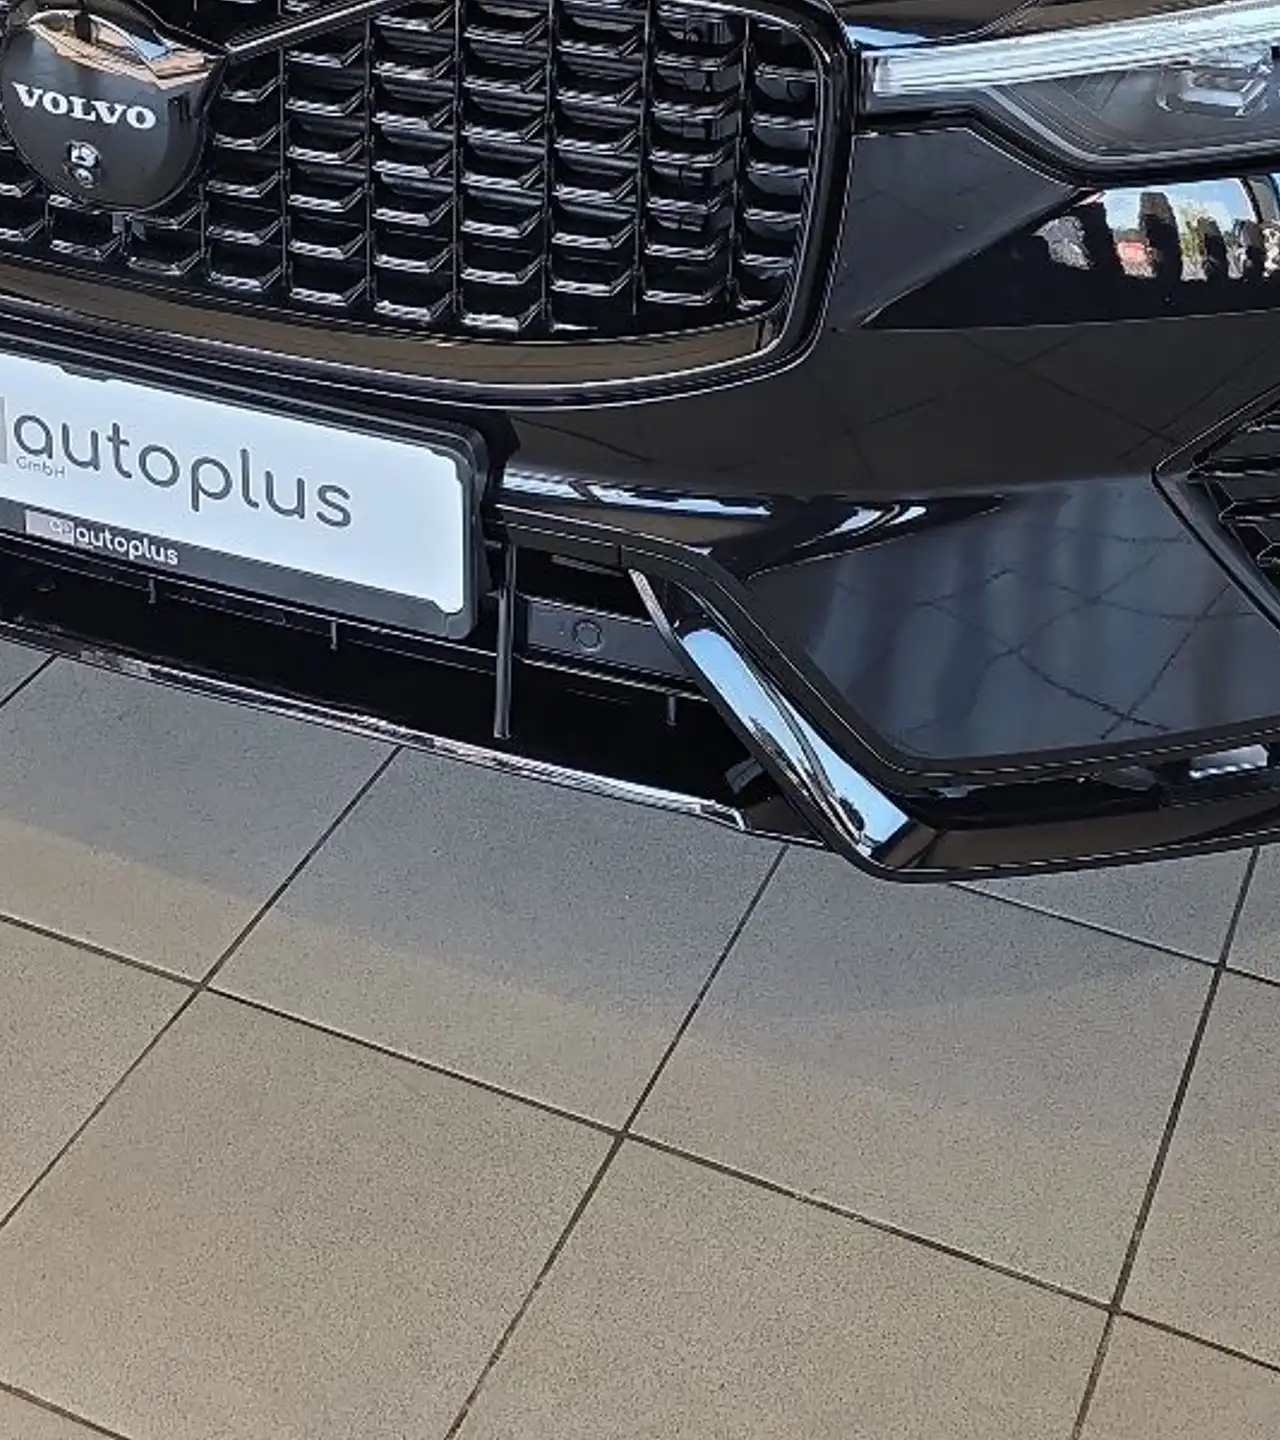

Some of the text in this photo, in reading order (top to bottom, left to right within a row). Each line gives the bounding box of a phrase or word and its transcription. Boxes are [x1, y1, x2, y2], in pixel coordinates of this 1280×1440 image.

[11, 81, 157, 129] VOLVO
[13, 414, 352, 527] autoplus
[16, 455, 66, 478] GmbH
[75, 527, 179, 566] autoplus
